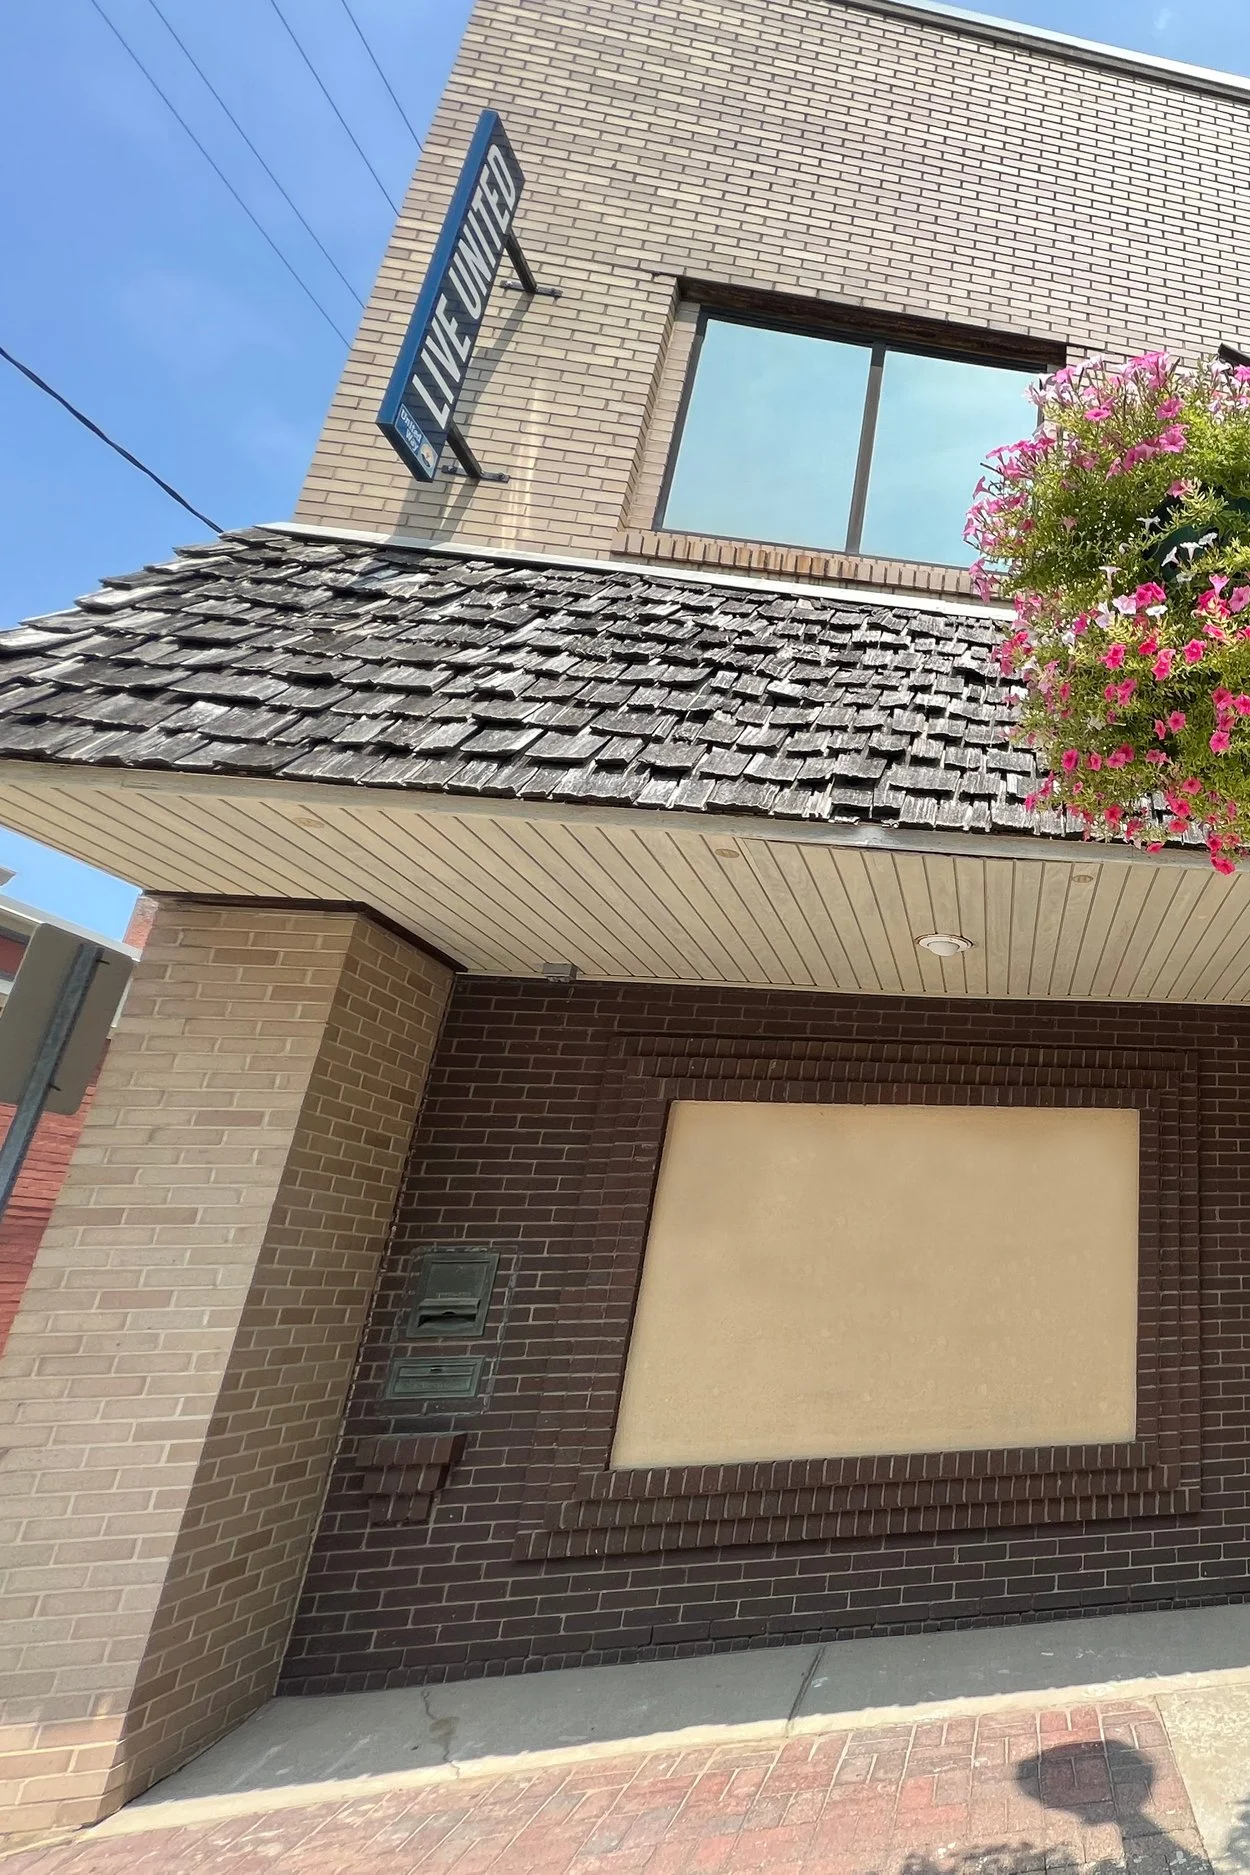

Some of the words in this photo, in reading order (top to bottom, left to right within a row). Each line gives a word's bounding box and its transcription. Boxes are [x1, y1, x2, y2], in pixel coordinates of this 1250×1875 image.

[412, 293, 471, 429] LIVE
[449, 143, 516, 321] UNITED
[401, 409, 422, 443] United
[406, 428, 419, 452] Way
